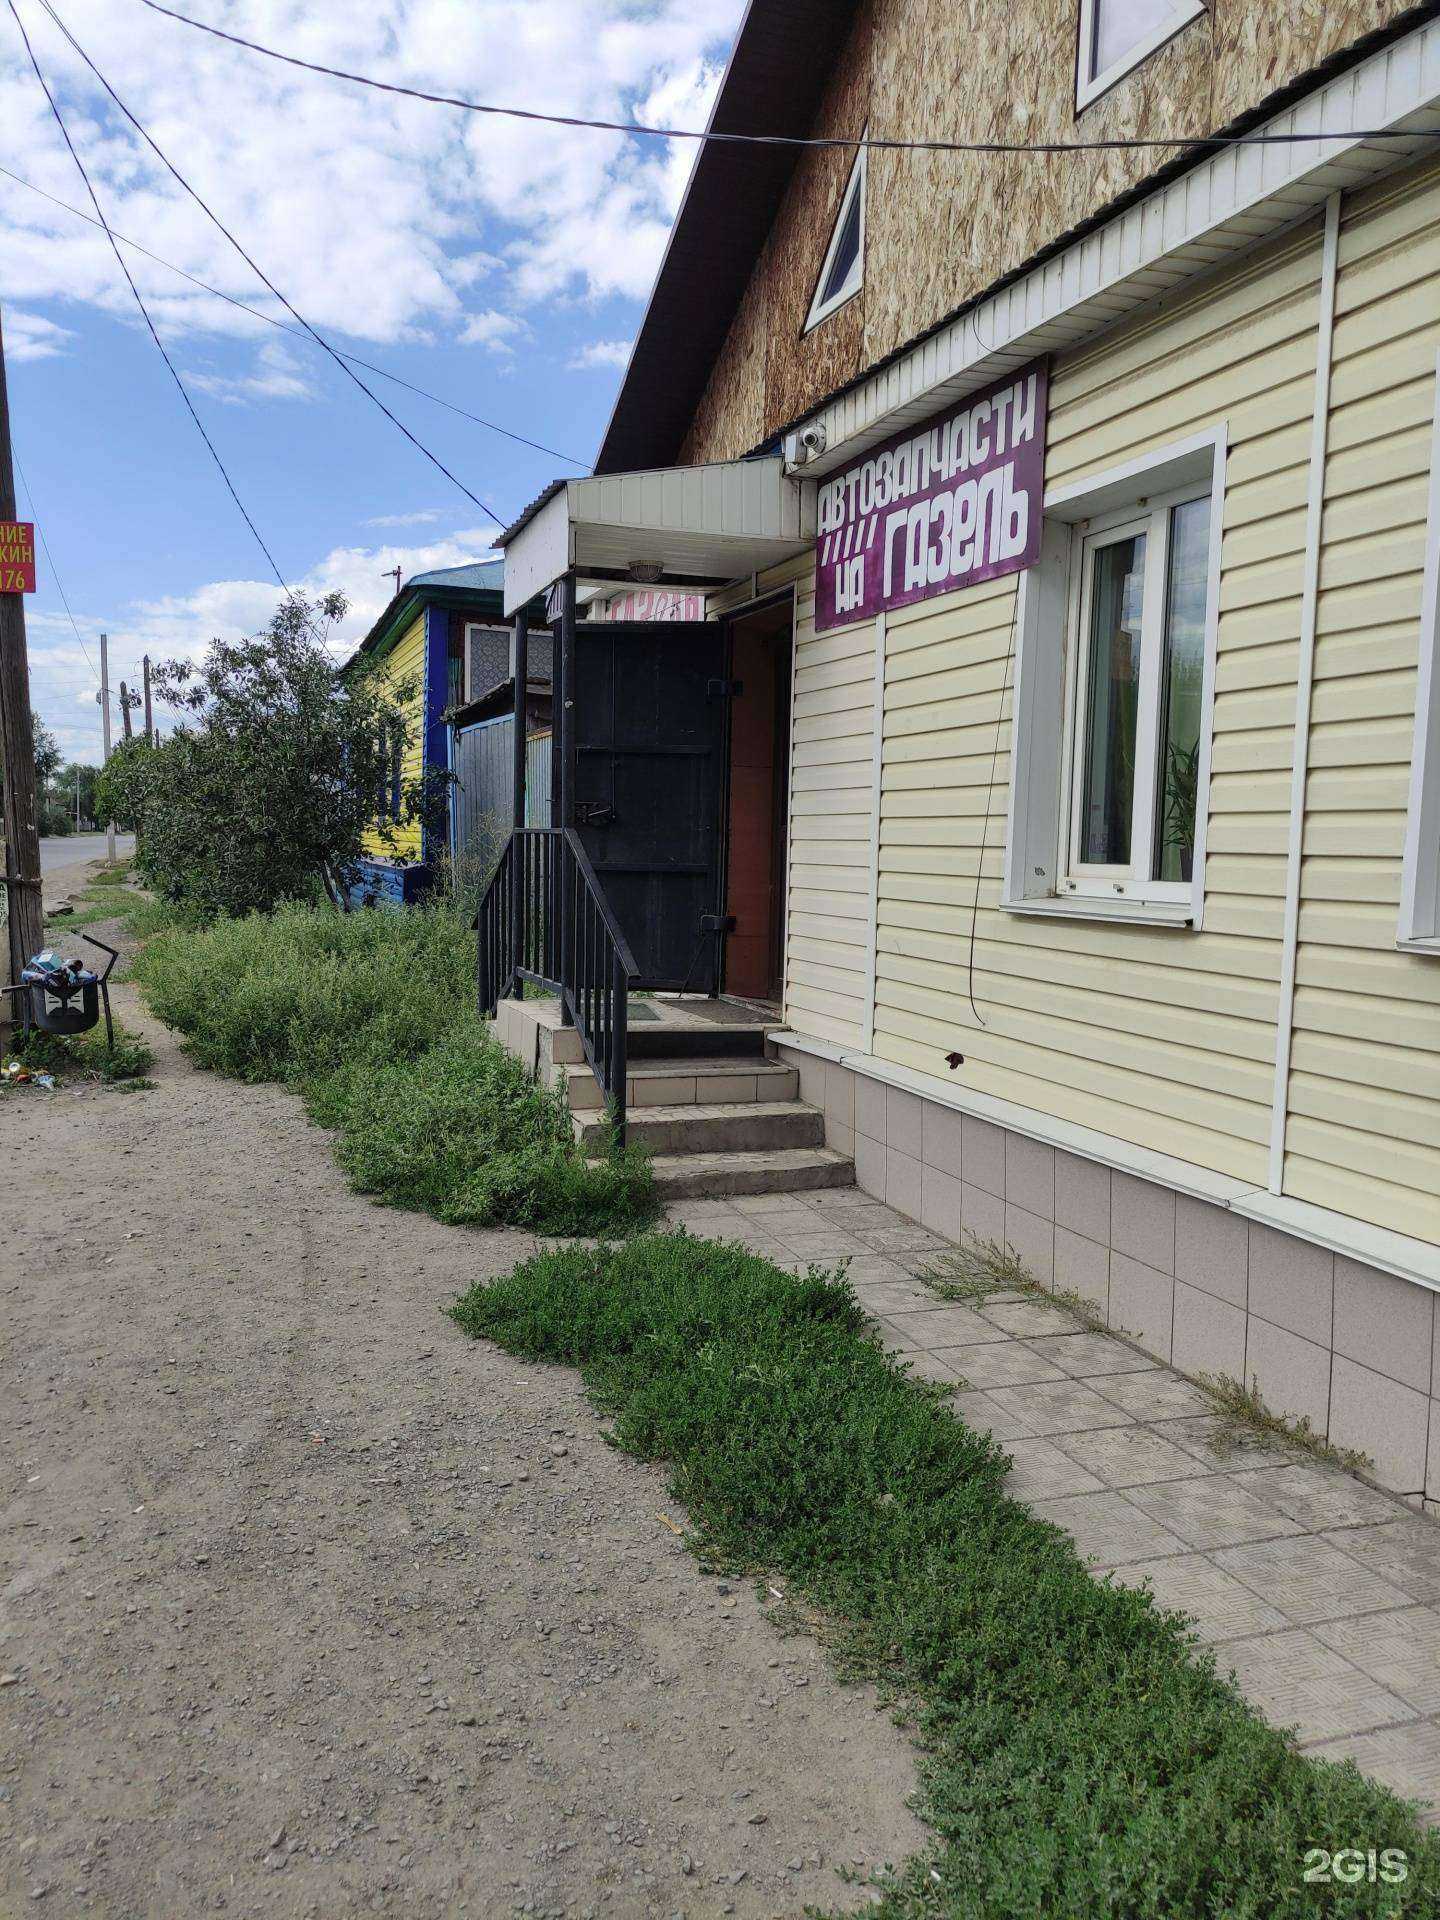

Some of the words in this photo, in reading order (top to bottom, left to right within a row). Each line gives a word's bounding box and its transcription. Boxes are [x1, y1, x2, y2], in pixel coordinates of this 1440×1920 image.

[817, 373, 1037, 537] АВТОЗАПЧАСТИ
[835, 554, 865, 614] НА
[882, 461, 1029, 598] ГАЗЕЛЬ
